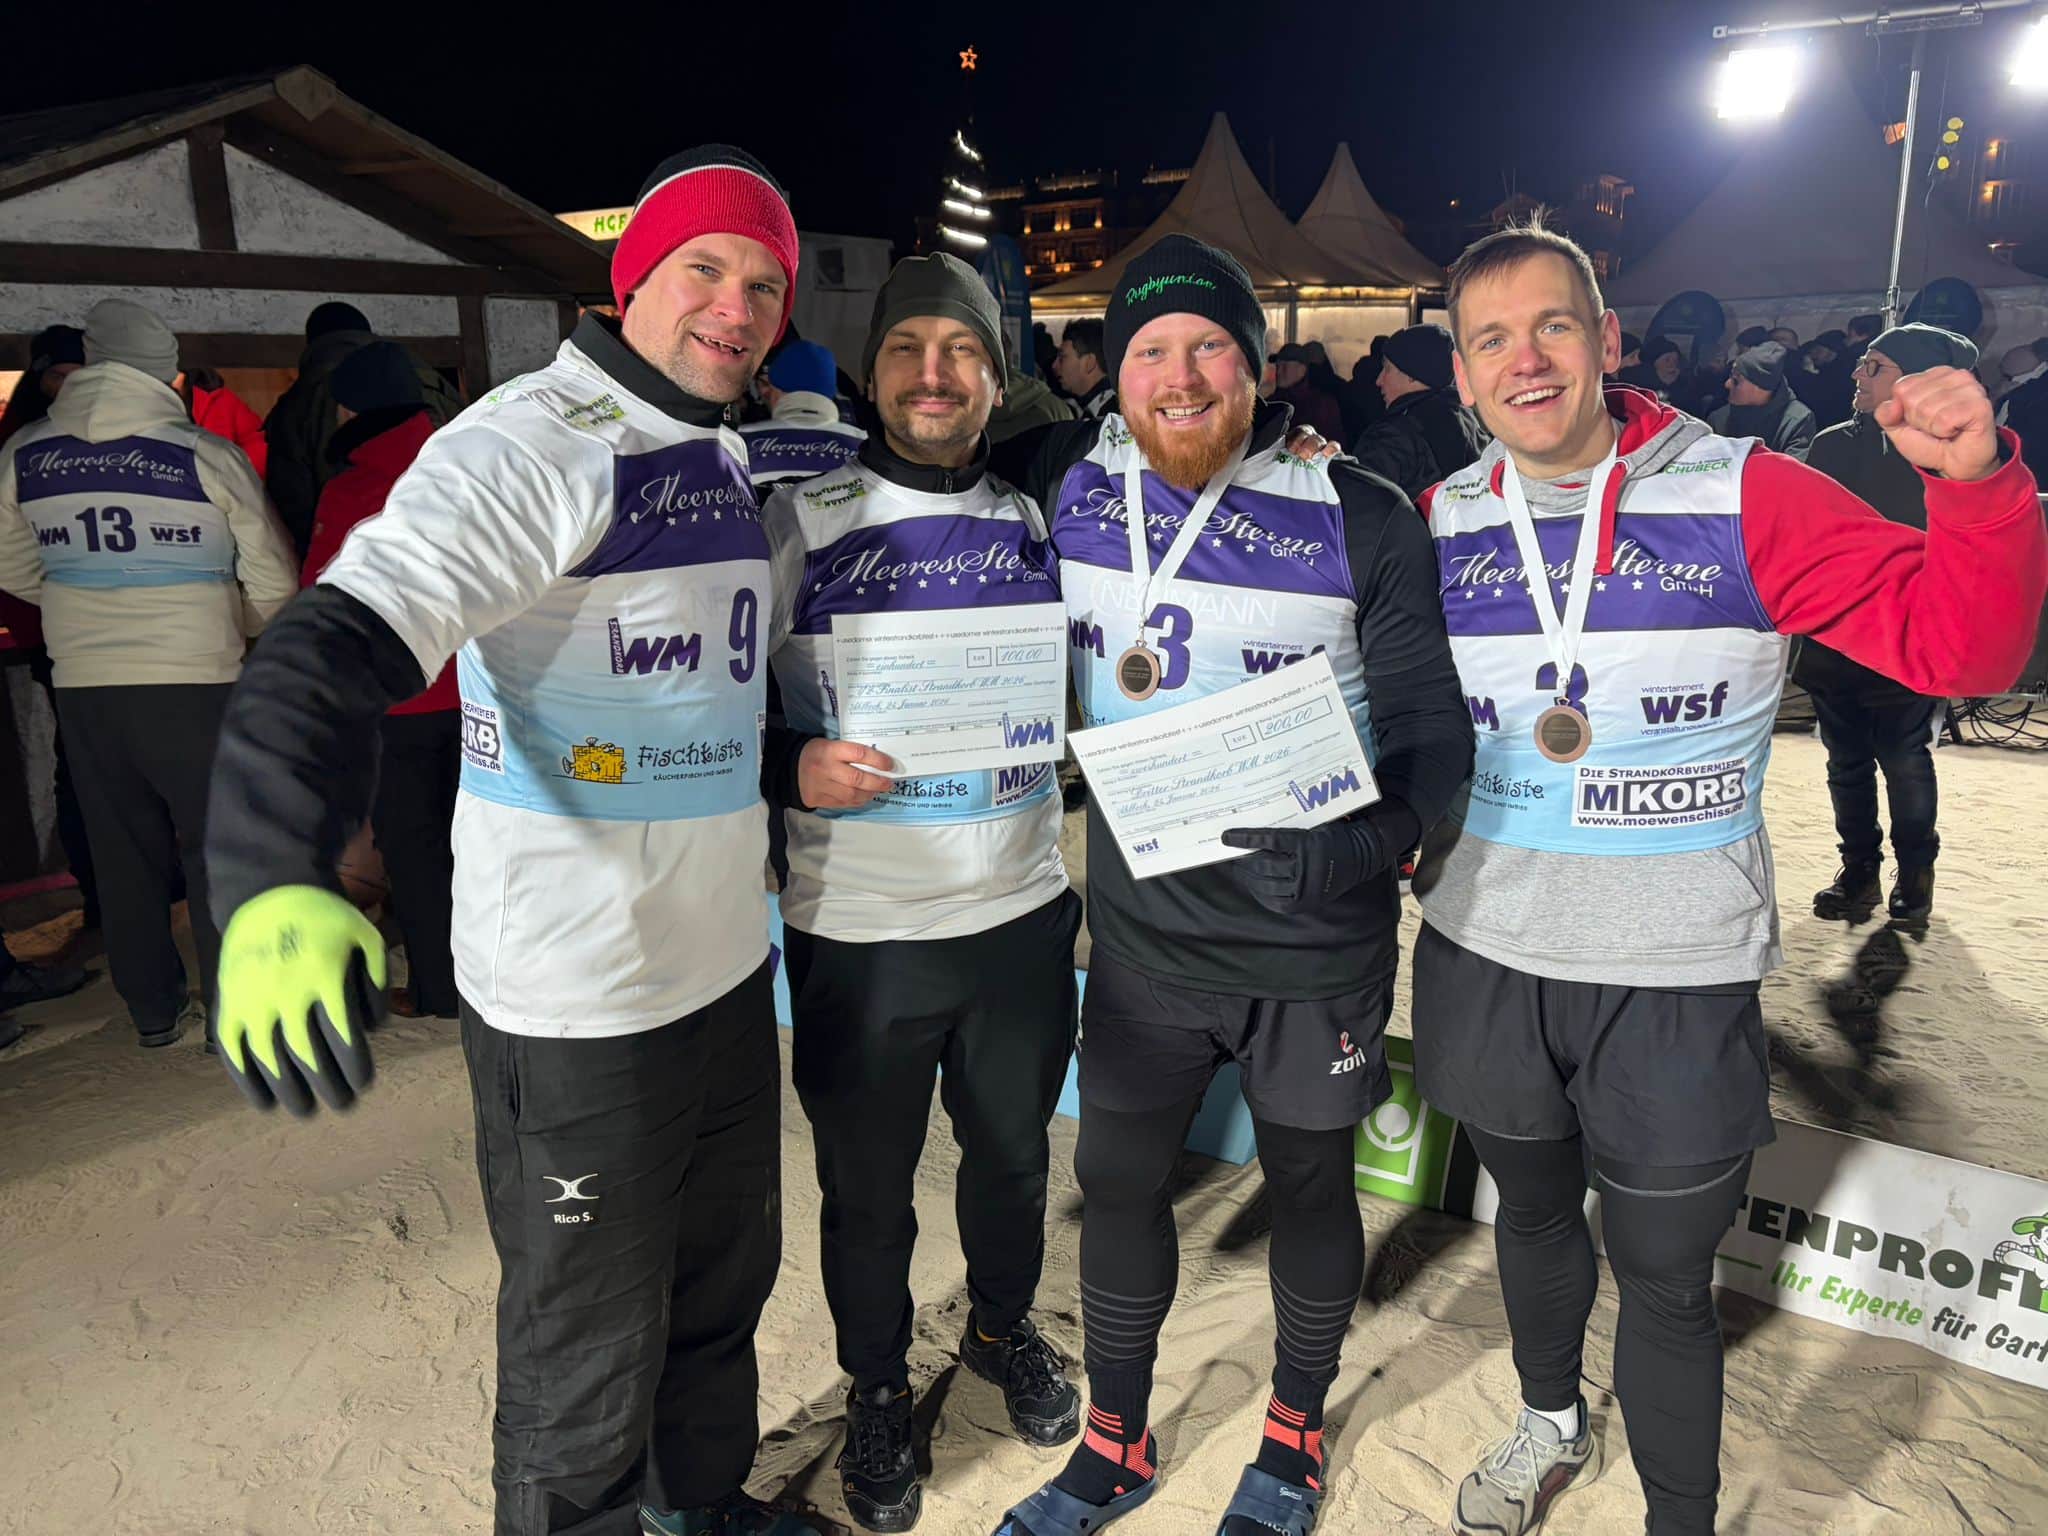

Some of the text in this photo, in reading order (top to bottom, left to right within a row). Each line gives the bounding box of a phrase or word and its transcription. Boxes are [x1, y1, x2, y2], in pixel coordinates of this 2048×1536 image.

[1664, 461, 1730, 474] CHUBECK
[75, 506, 137, 553] 13
[150, 526, 203, 543] wsf
[814, 541, 1036, 593] MeeresSte
[1101, 579, 1277, 627] NEMANN
[617, 632, 702, 676] WM
[728, 587, 758, 684] 9
[1146, 602, 1194, 690] 3
[1243, 640, 1304, 651] wintertainment
[1640, 681, 1729, 725] wsf
[1641, 683, 1705, 693] wintertainment
[638, 737, 744, 768] Fischkiste
[1580, 768, 1604, 779] DIE
[1132, 838, 1160, 854] wsf
[553, 1211, 594, 1224] Rico S.
[1770, 1260, 1813, 1292] Ihr
[1819, 1275, 1924, 1326] Experte
[1932, 1306, 1978, 1341] für
